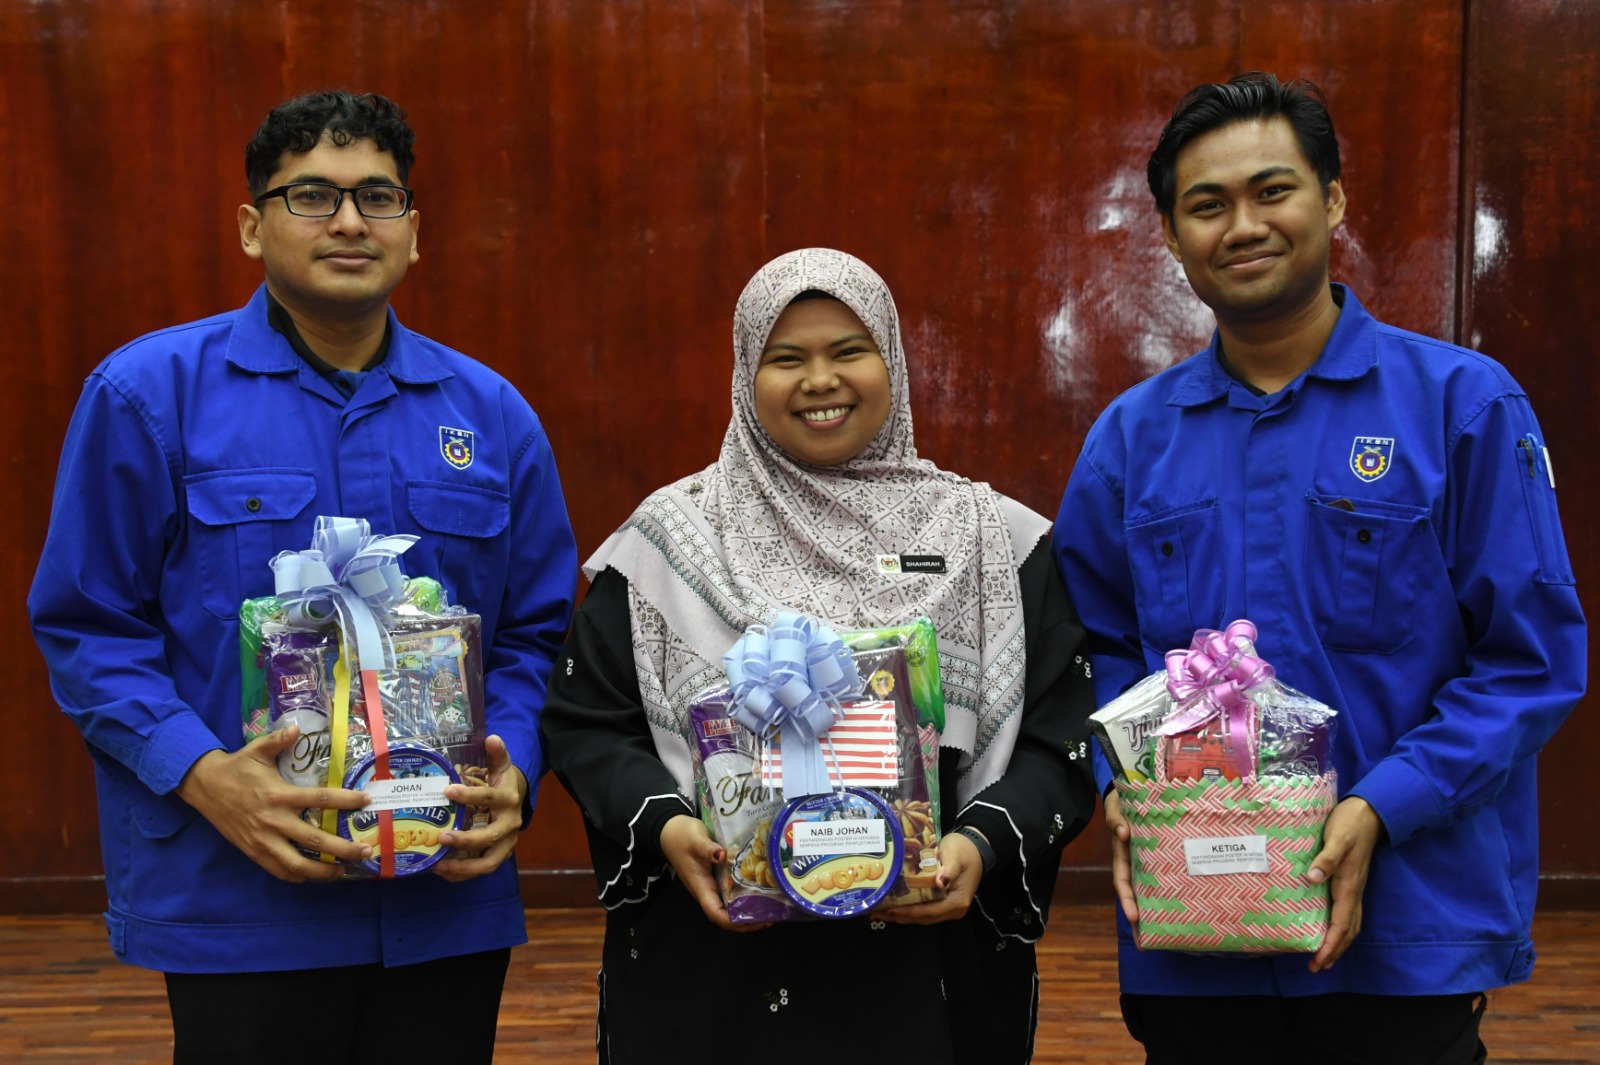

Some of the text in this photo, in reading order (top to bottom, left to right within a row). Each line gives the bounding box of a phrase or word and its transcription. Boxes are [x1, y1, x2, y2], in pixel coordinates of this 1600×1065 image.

[391, 784, 422, 793] JOHAN
[810, 827, 868, 836] NAIB JOHAN
[1212, 844, 1246, 852] KETIGA
